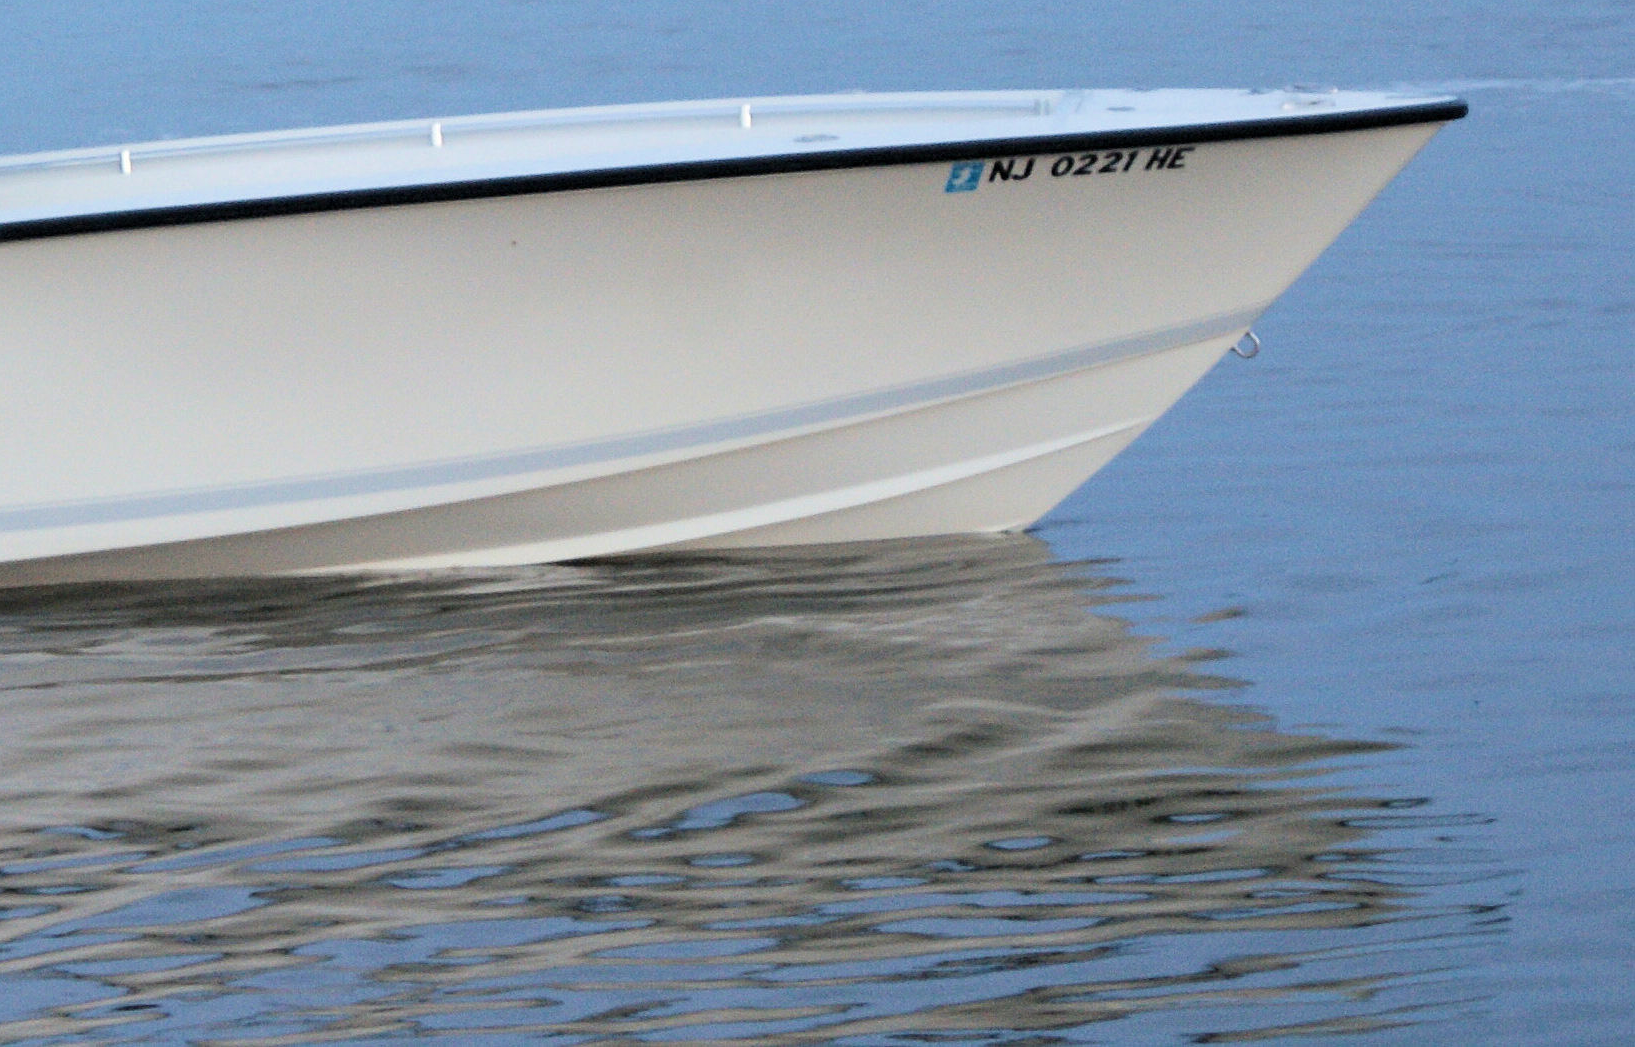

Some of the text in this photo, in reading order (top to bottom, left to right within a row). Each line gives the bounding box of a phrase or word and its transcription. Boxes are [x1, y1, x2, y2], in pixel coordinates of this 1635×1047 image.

[989, 147, 1195, 182] NJ 0221 HE
